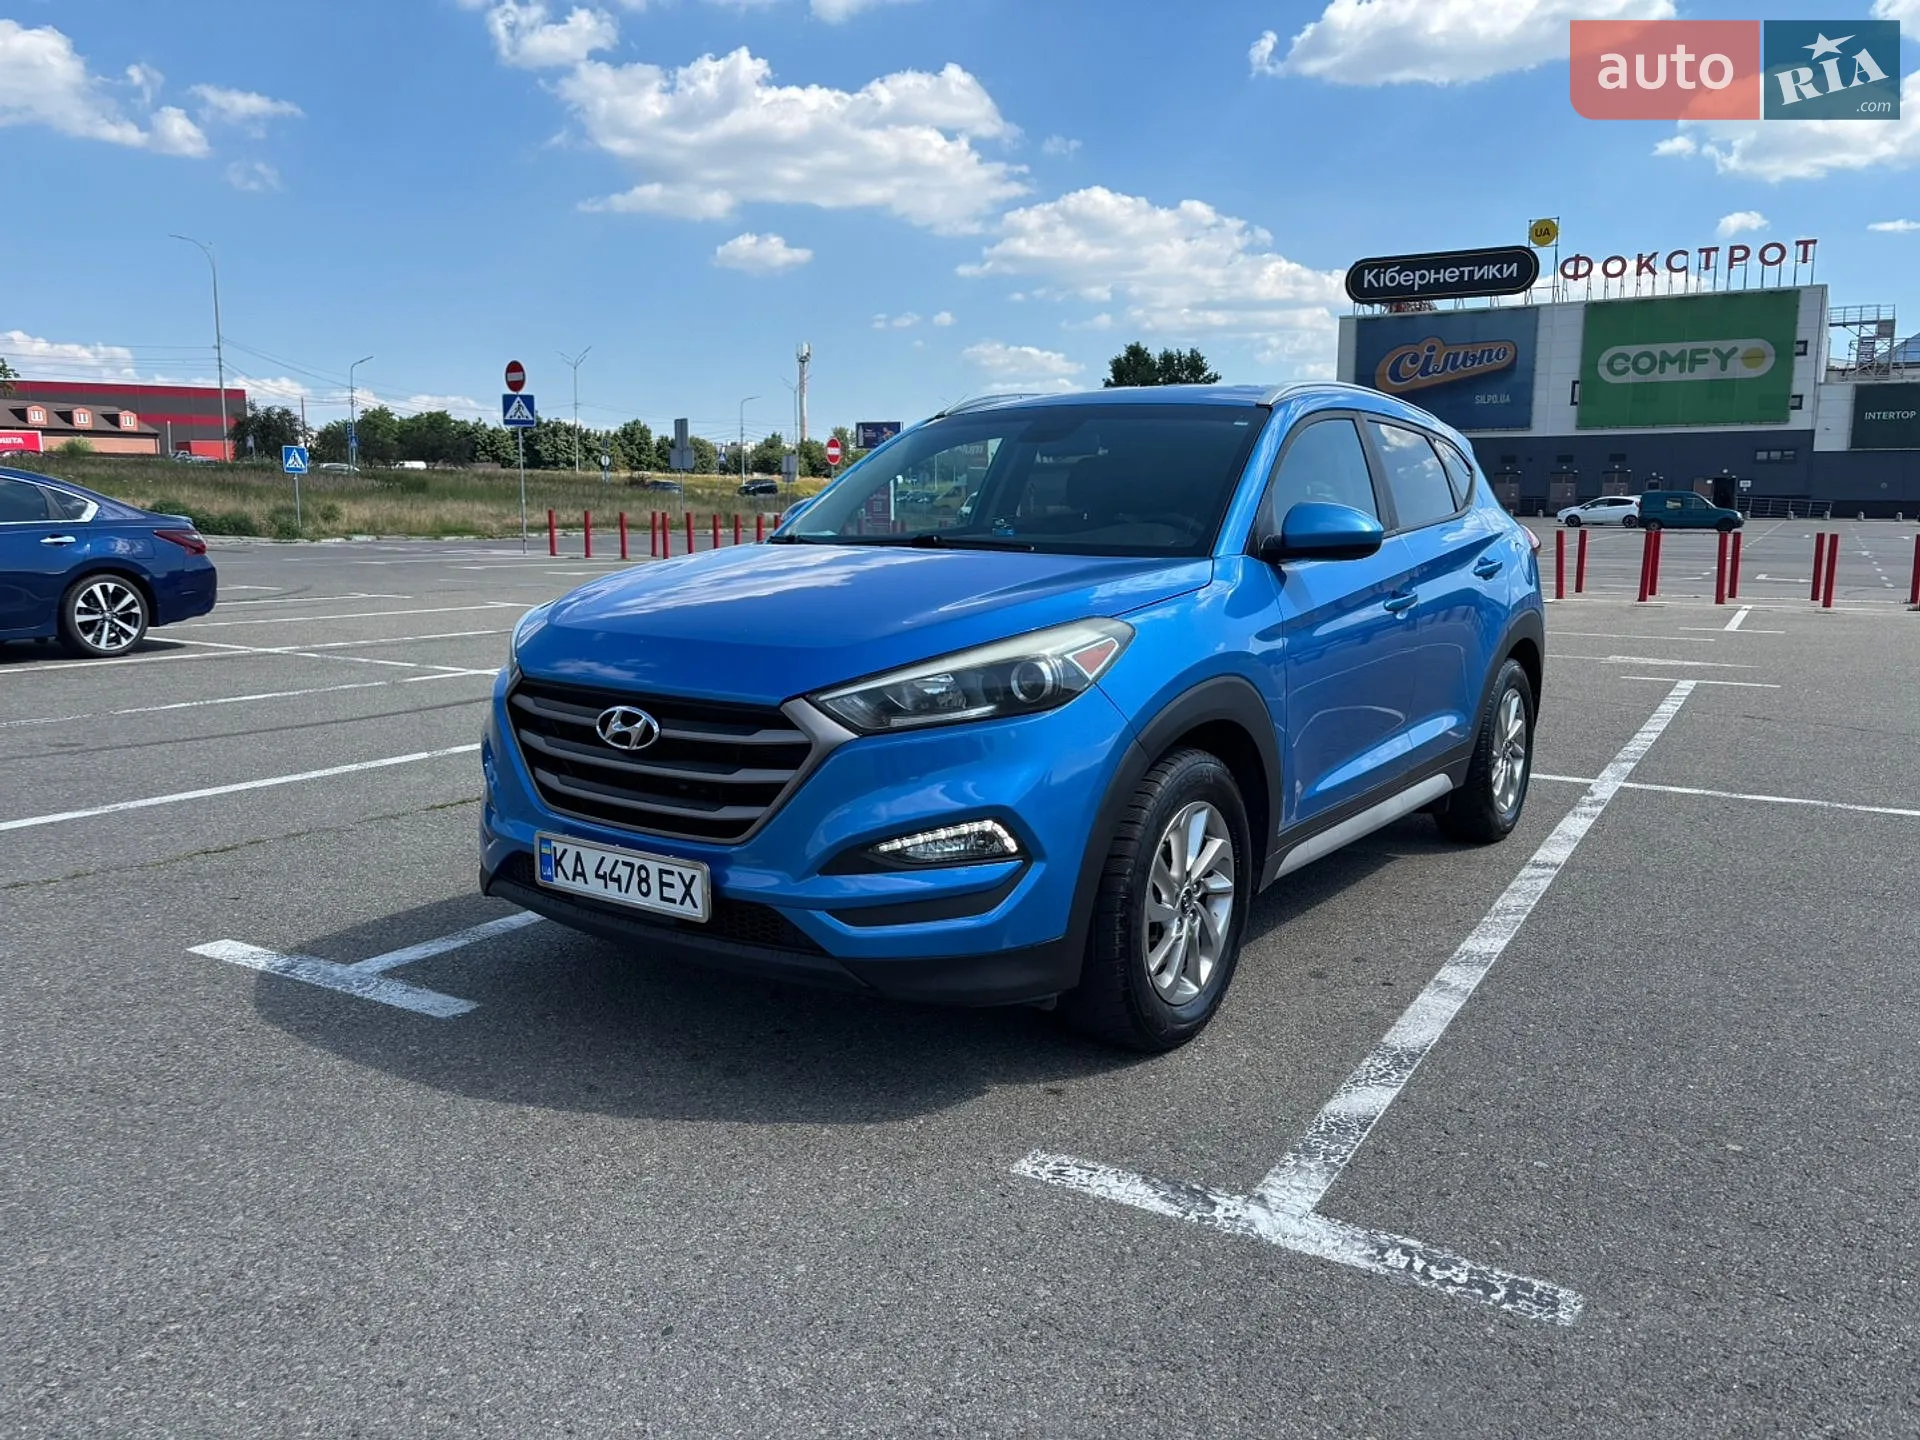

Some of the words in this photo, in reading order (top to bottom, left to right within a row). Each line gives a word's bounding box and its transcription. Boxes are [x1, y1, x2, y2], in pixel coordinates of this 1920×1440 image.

[1535, 227, 1551, 238] UA
[1559, 238, 1818, 282] ФОКСТРОТ
[1363, 262, 1518, 291] Кібернетики
[1385, 344, 1511, 386] Сільпо
[1605, 346, 1739, 377] COMFY
[1864, 410, 1917, 420] INTERTOP
[553, 846, 588, 885] KA
[594, 856, 651, 898] 4478
[658, 868, 699, 909] EX
